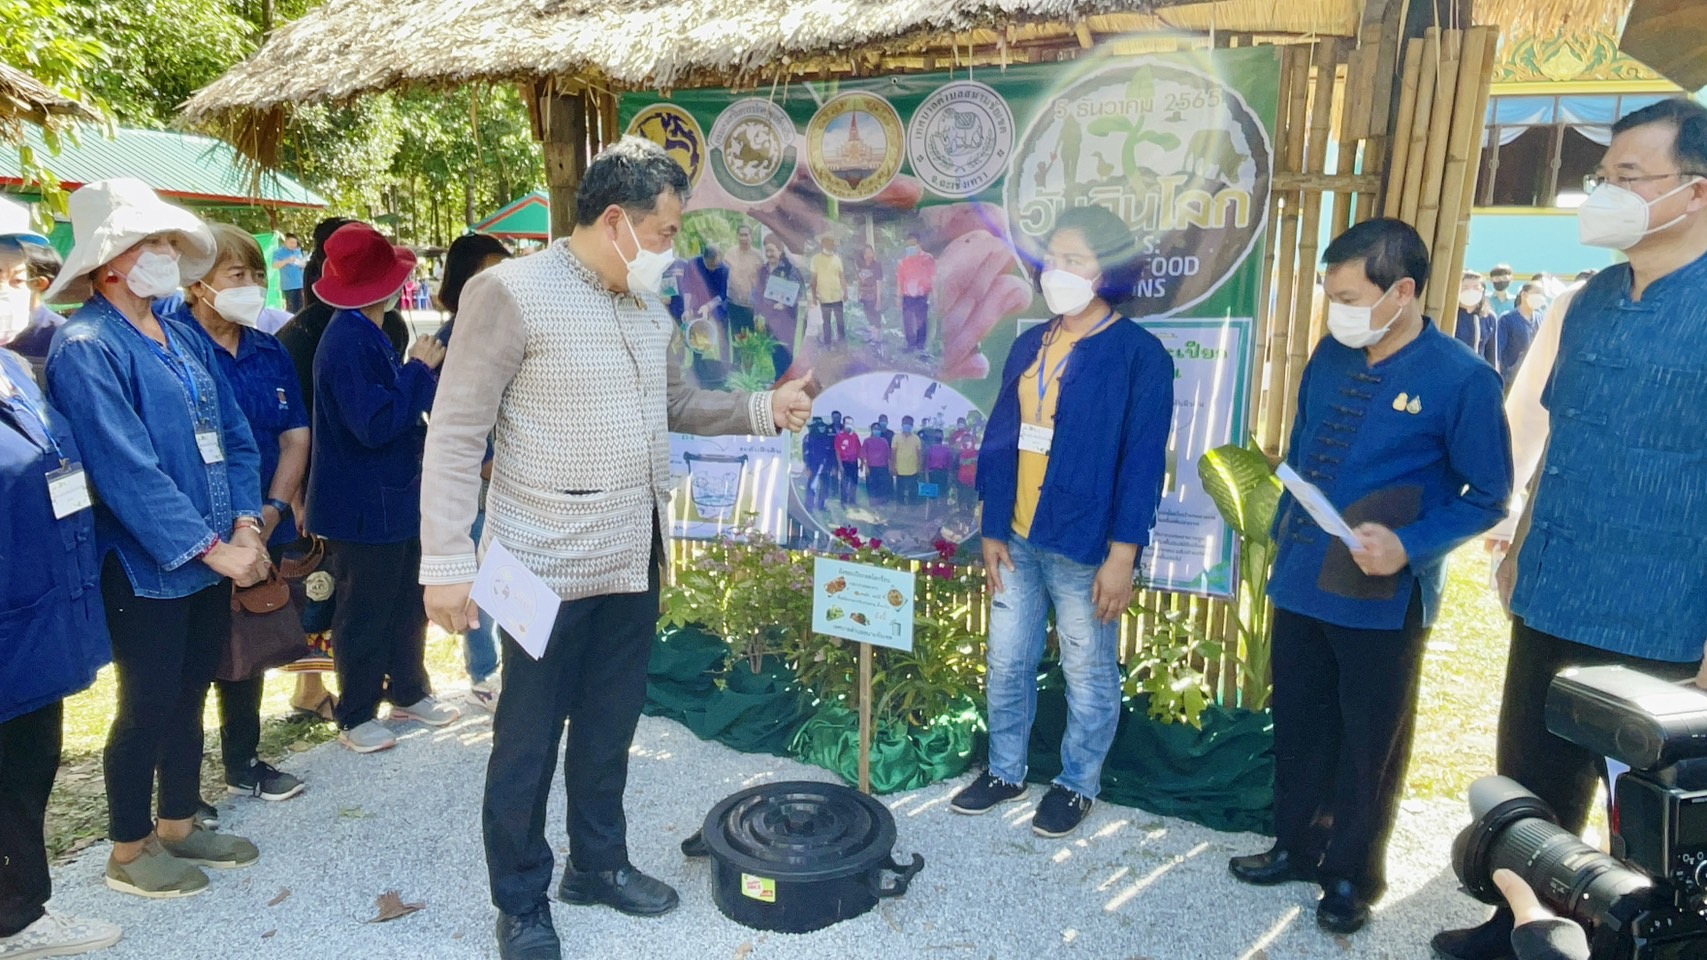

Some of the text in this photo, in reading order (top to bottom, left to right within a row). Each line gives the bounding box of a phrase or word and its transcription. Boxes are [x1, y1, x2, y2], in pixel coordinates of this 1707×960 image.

[1054, 89, 1221, 118] 5 ธันวาคม 2565
